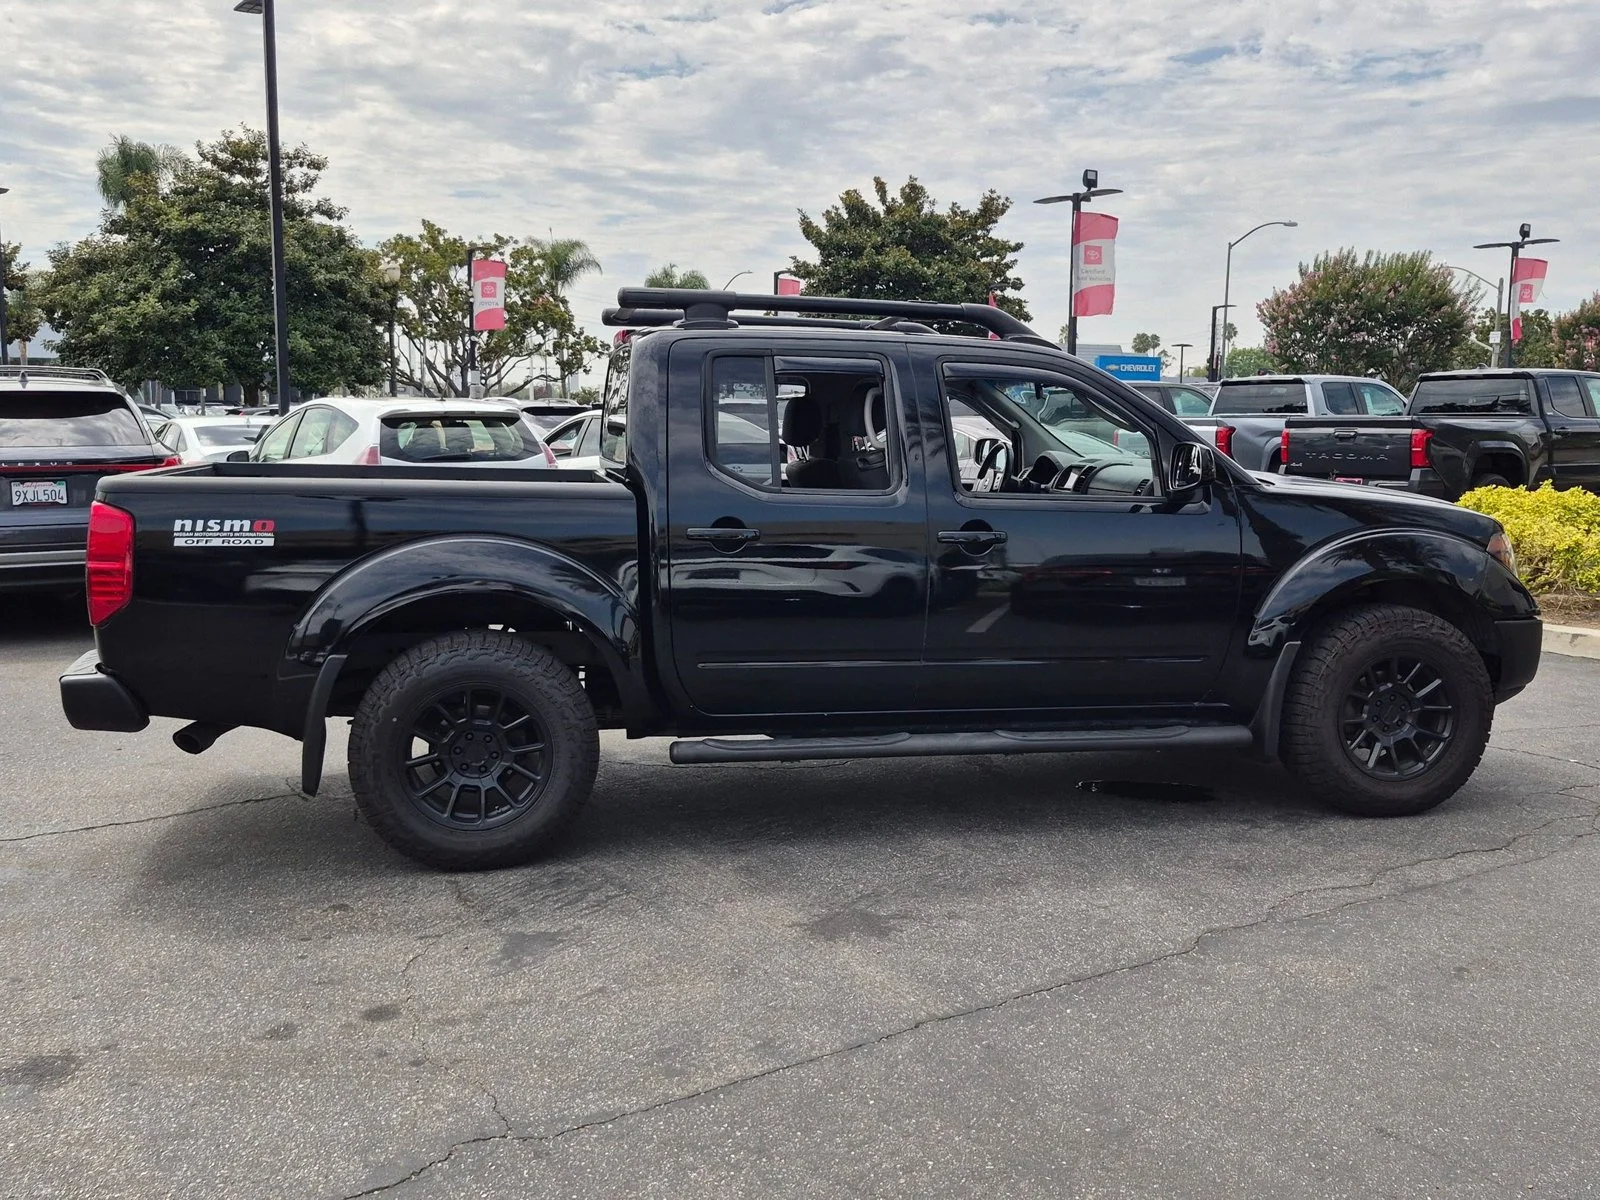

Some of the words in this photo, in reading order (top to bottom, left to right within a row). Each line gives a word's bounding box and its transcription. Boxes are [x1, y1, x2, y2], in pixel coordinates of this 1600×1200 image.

[1120, 364, 1156, 372] CHEVROLET
[1305, 452, 1389, 461] TACOMA
[14, 489, 64, 502] 9XJL504
[173, 519, 275, 532] nismo
